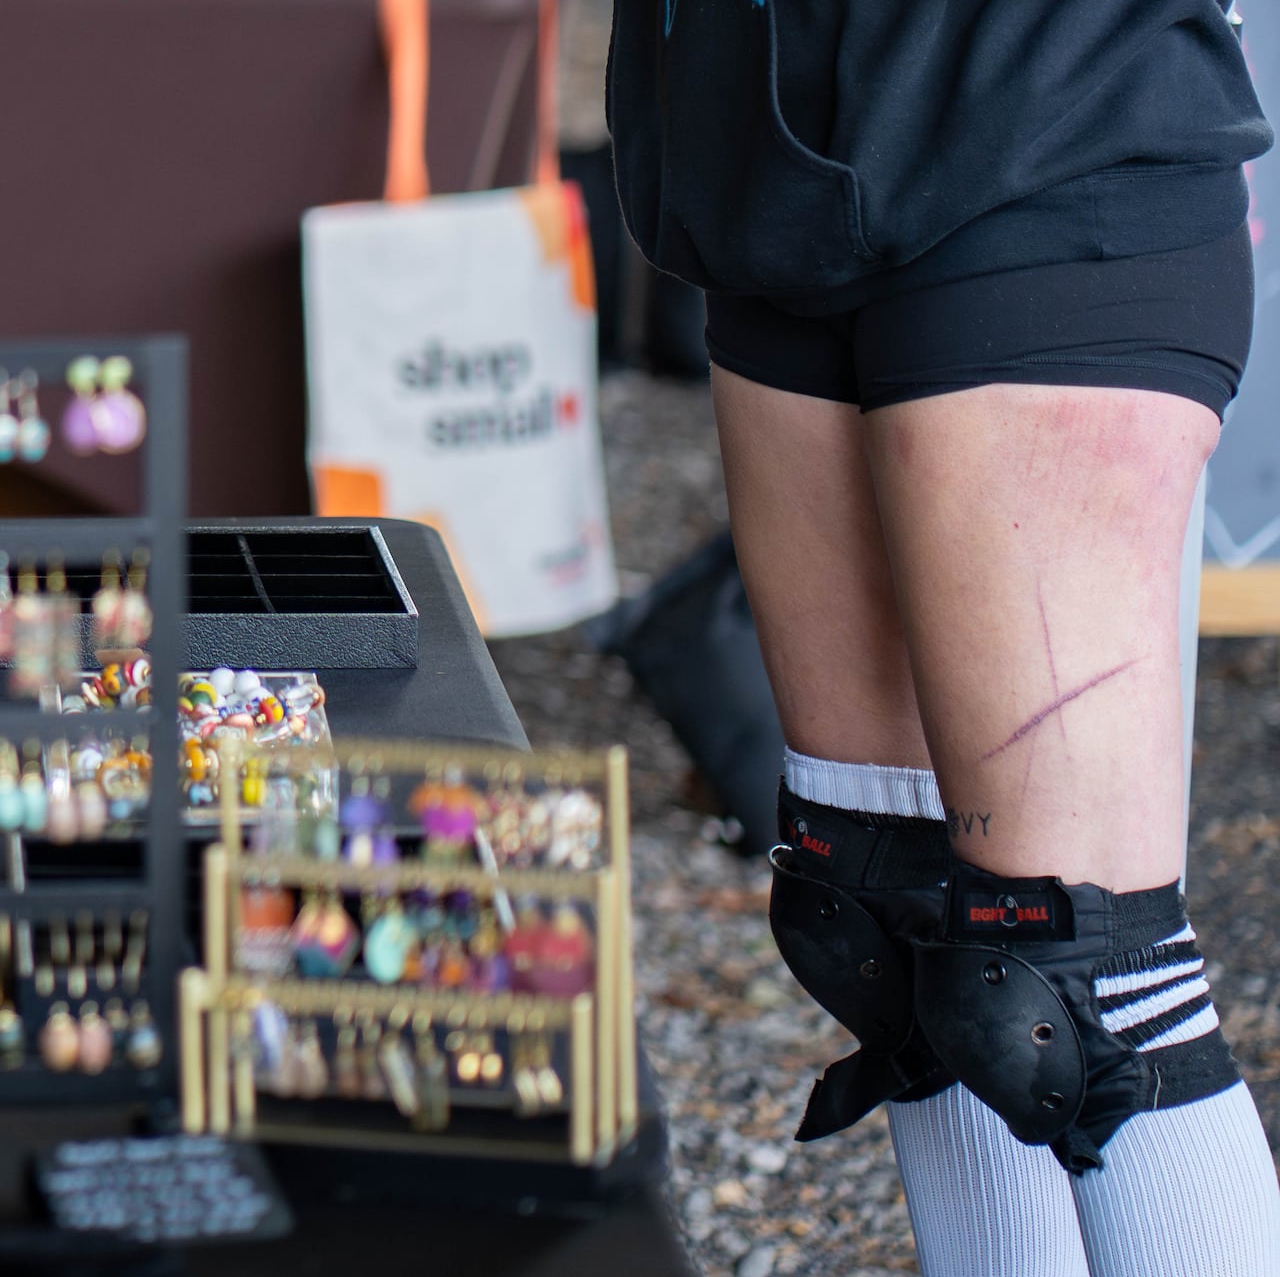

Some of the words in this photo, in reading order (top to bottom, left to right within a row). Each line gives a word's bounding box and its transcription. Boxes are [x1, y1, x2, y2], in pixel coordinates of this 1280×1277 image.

[397, 339, 533, 394] shop
[425, 382, 554, 446] small
[802, 835, 832, 857] BALL
[970, 907, 1007, 922] EIGHT
[1016, 906, 1049, 922] BALL
